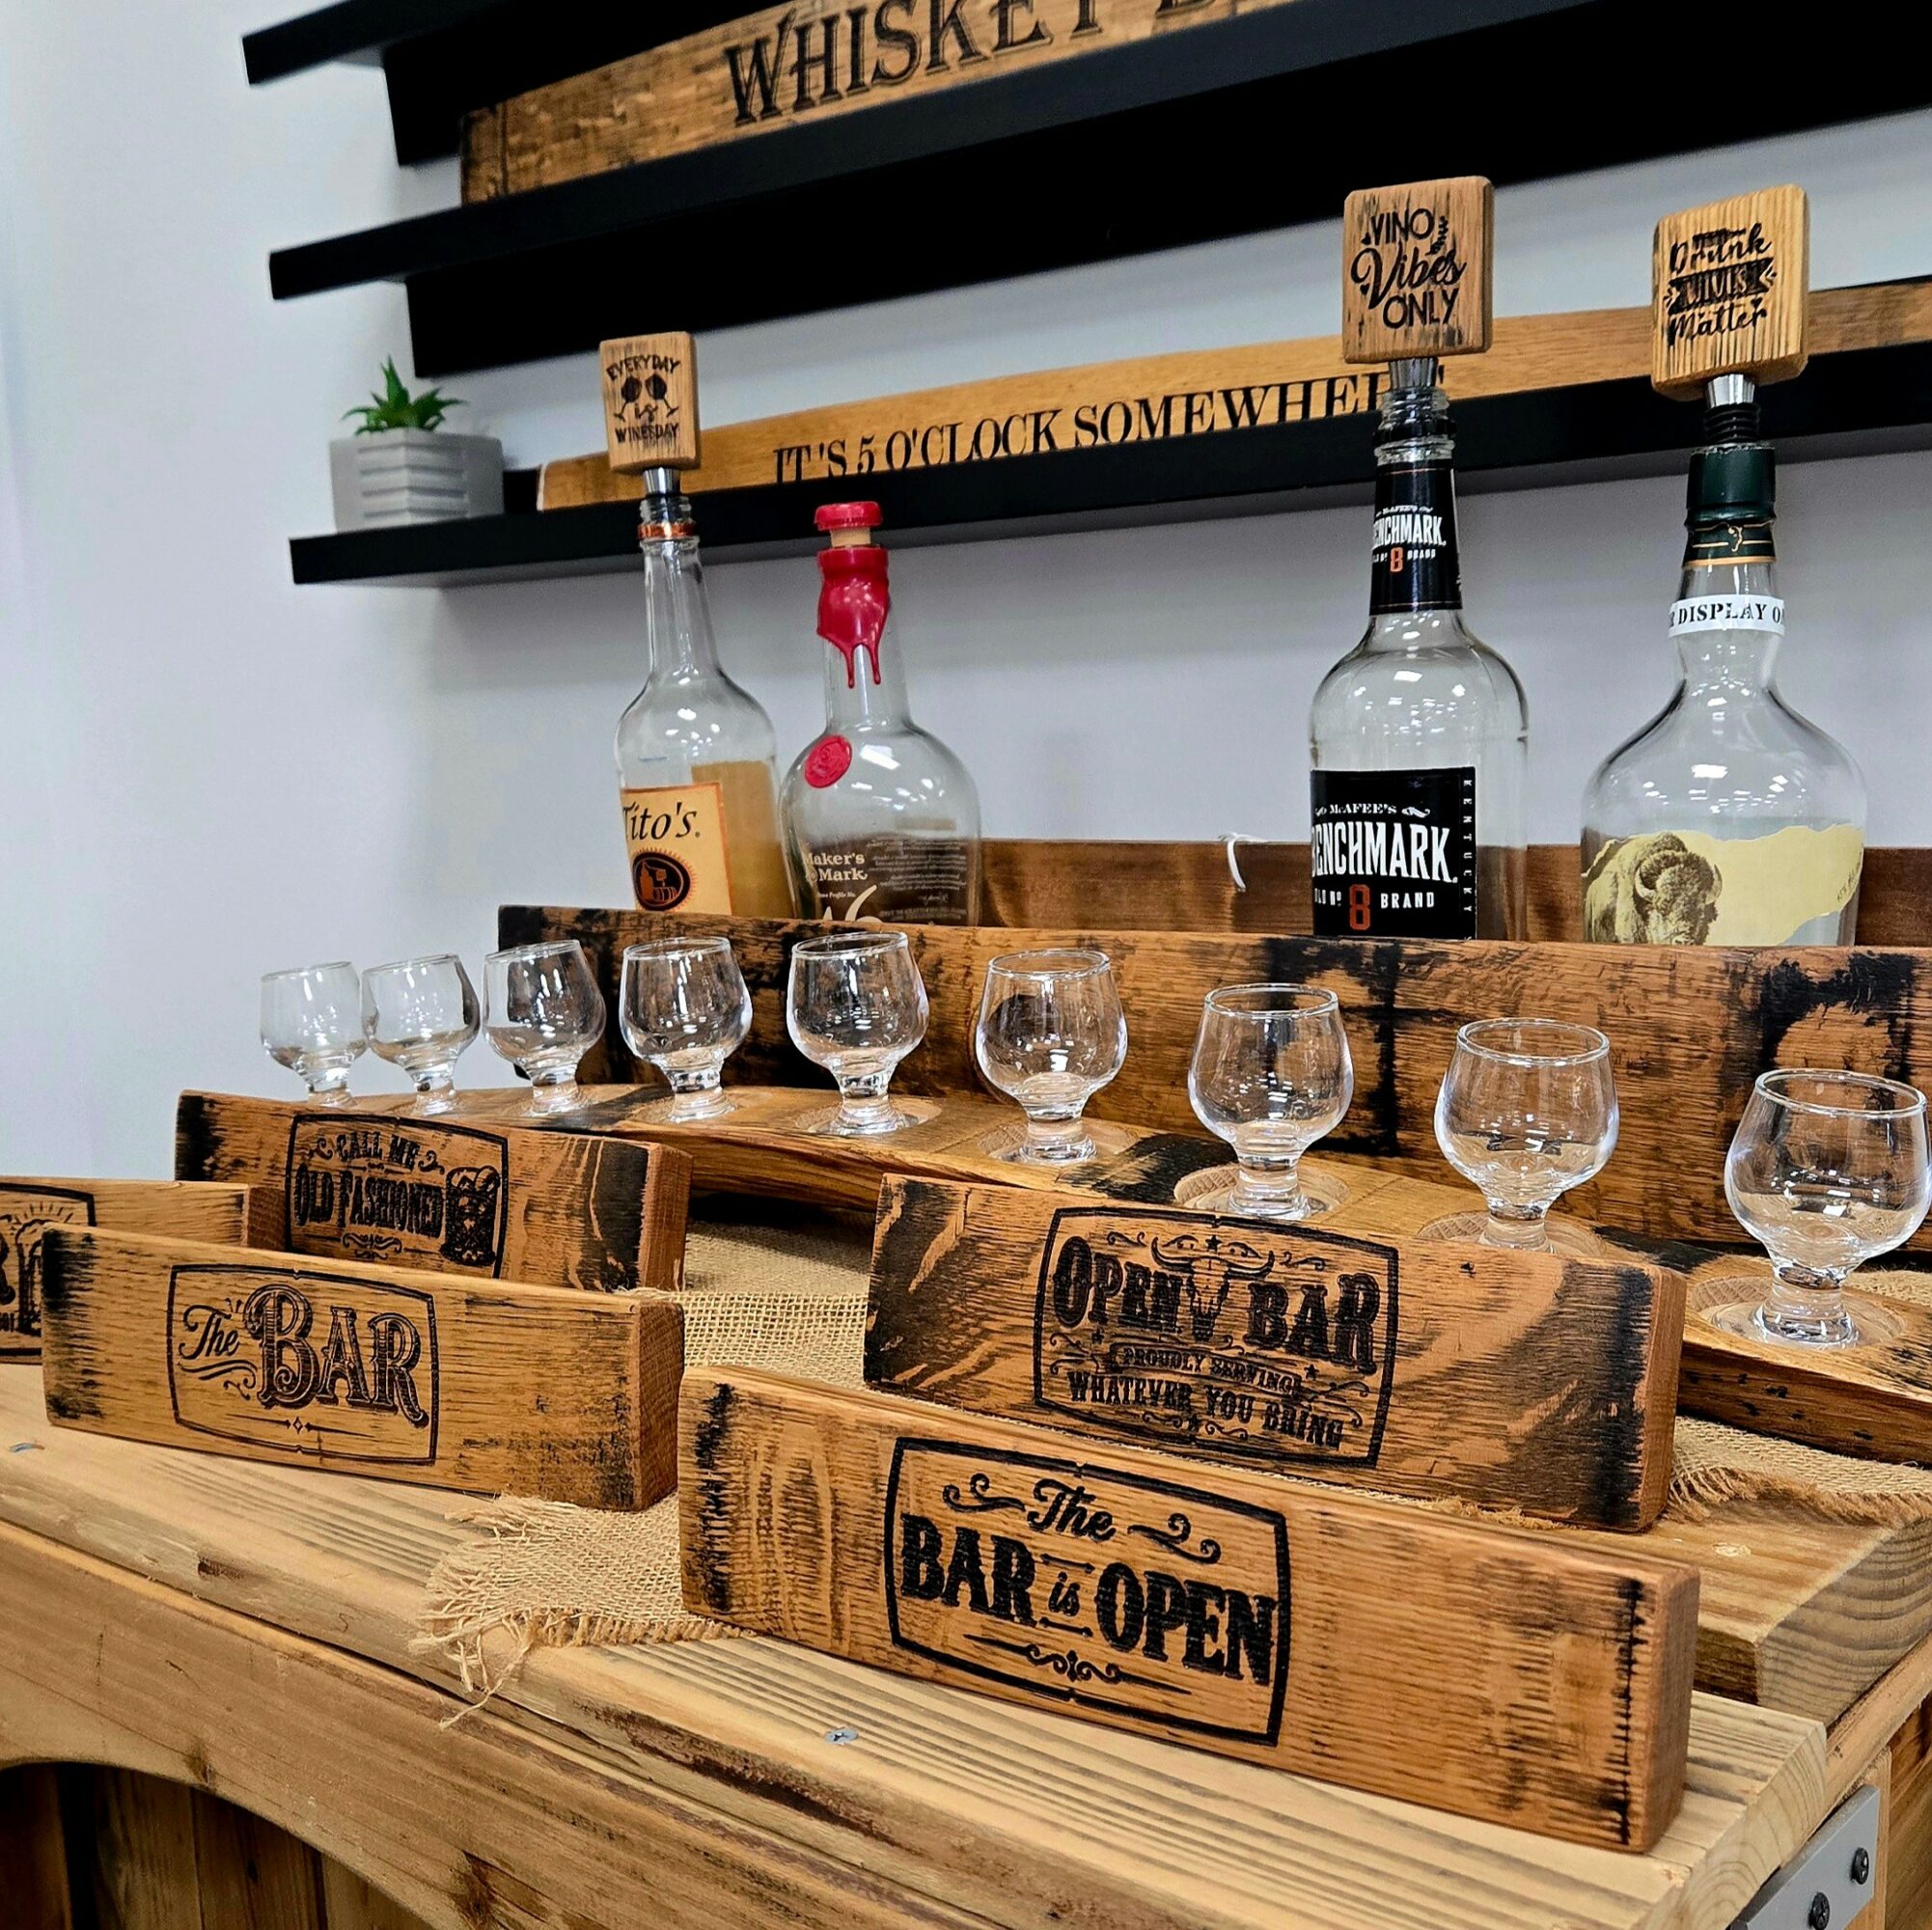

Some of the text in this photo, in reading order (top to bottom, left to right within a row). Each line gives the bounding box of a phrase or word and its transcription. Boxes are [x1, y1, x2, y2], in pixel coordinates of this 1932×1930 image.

[1370, 207, 1435, 246] VINO
[1351, 240, 1467, 310] Vibes
[1383, 289, 1459, 329] ONLY
[1668, 303, 1767, 346] Matter
[606, 354, 681, 381] EVERYDAY
[773, 365, 1445, 483] IT'S 5 O'CLOCK SOMEWHE
[1372, 513, 1443, 549] ENCHMARK
[1391, 547, 1404, 572] 8
[1678, 602, 1768, 626] DISPLAY
[1330, 803, 1397, 814] McAFEE'S
[1463, 780, 1473, 912] KENTUCKY
[818, 868, 869, 882] Mark
[1349, 884, 1371, 930] 8
[1381, 893, 1435, 909] BRAND
[336, 1130, 382, 1162] CALL
[1053, 1235, 1381, 1375] OPEN BAR
[179, 1283, 429, 1429] The BAR
[1122, 1346, 1303, 1398] PROUDLY SERVING
[1067, 1370, 1343, 1451] WHATEVER YOU BRING
[1028, 1478, 1117, 1542] The
[900, 1513, 1277, 1687] BAR is OPEN
